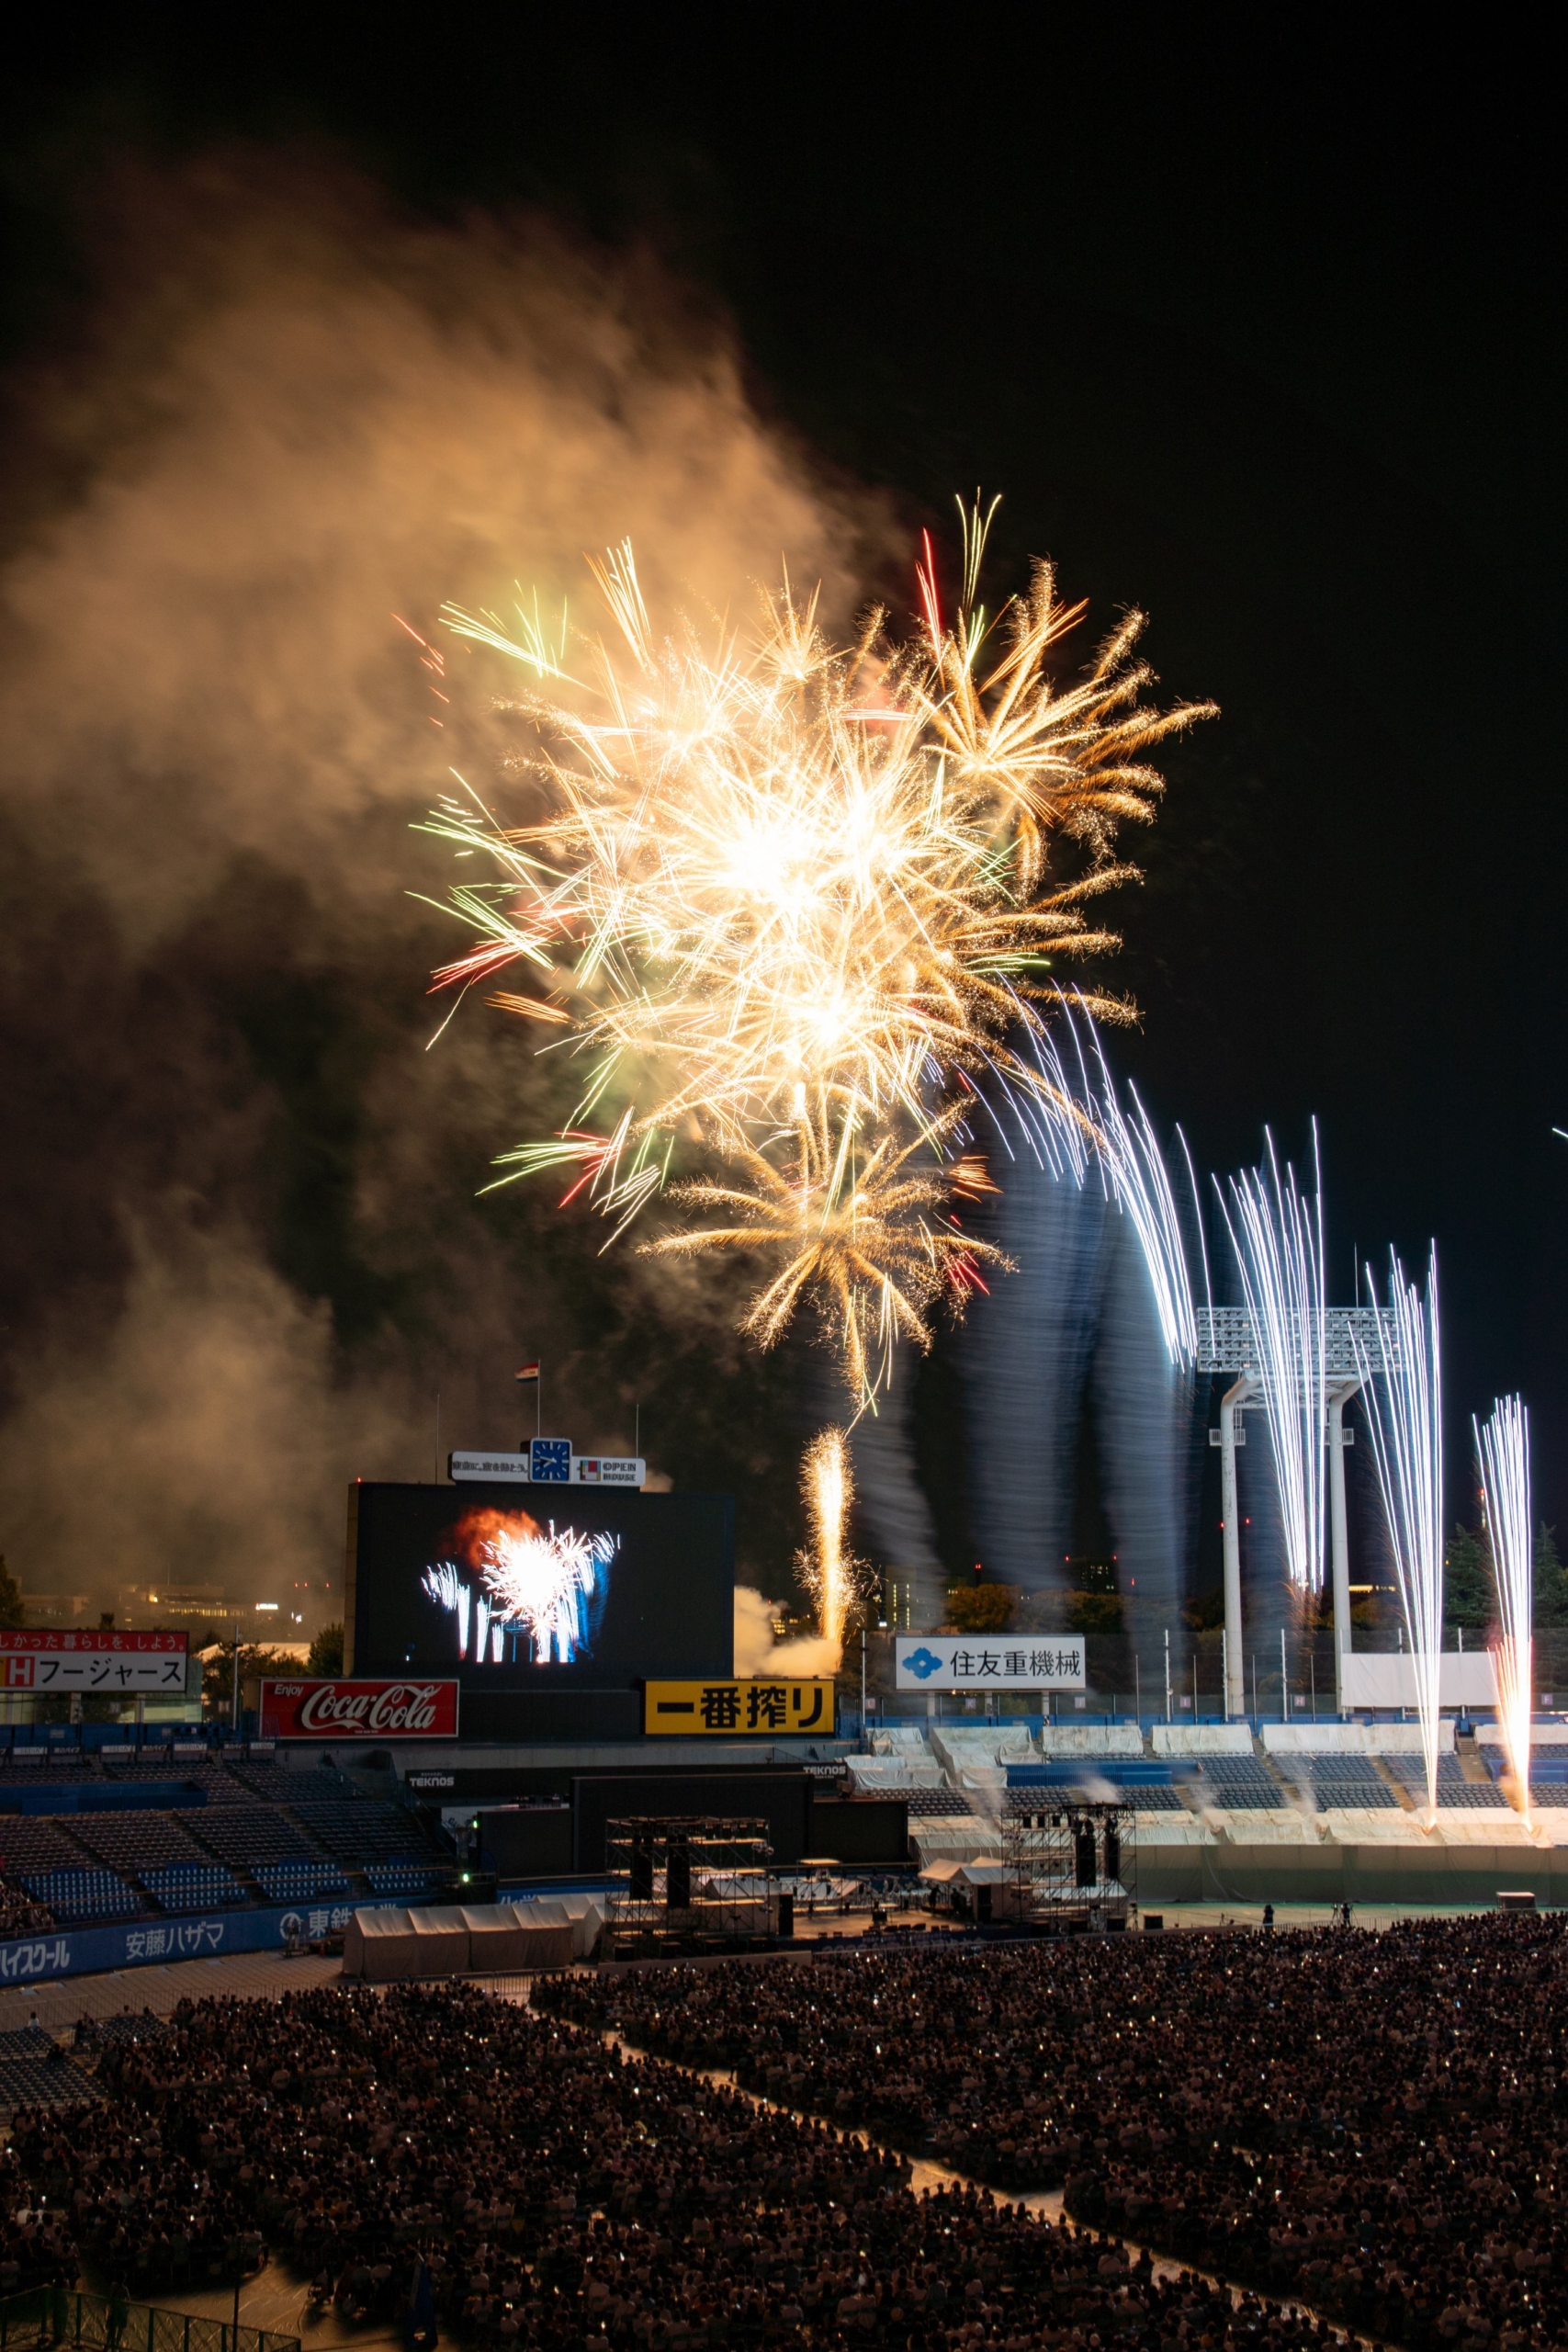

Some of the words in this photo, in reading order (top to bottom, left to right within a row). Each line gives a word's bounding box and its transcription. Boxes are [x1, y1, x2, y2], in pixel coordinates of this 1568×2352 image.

[603, 1462, 637, 1472] OPEN
[603, 1473, 637, 1481] HOUSE
[9, 1658, 31, 1685] H
[39, 1657, 182, 1686] フージャース
[950, 1649, 1081, 1678] 住友重機械
[275, 1684, 303, 1697] Enjoy
[301, 1685, 443, 1730] Coca-Cola
[657, 1686, 823, 1729] 一番搾り
[126, 1921, 224, 1961] 安藤ハザマ
